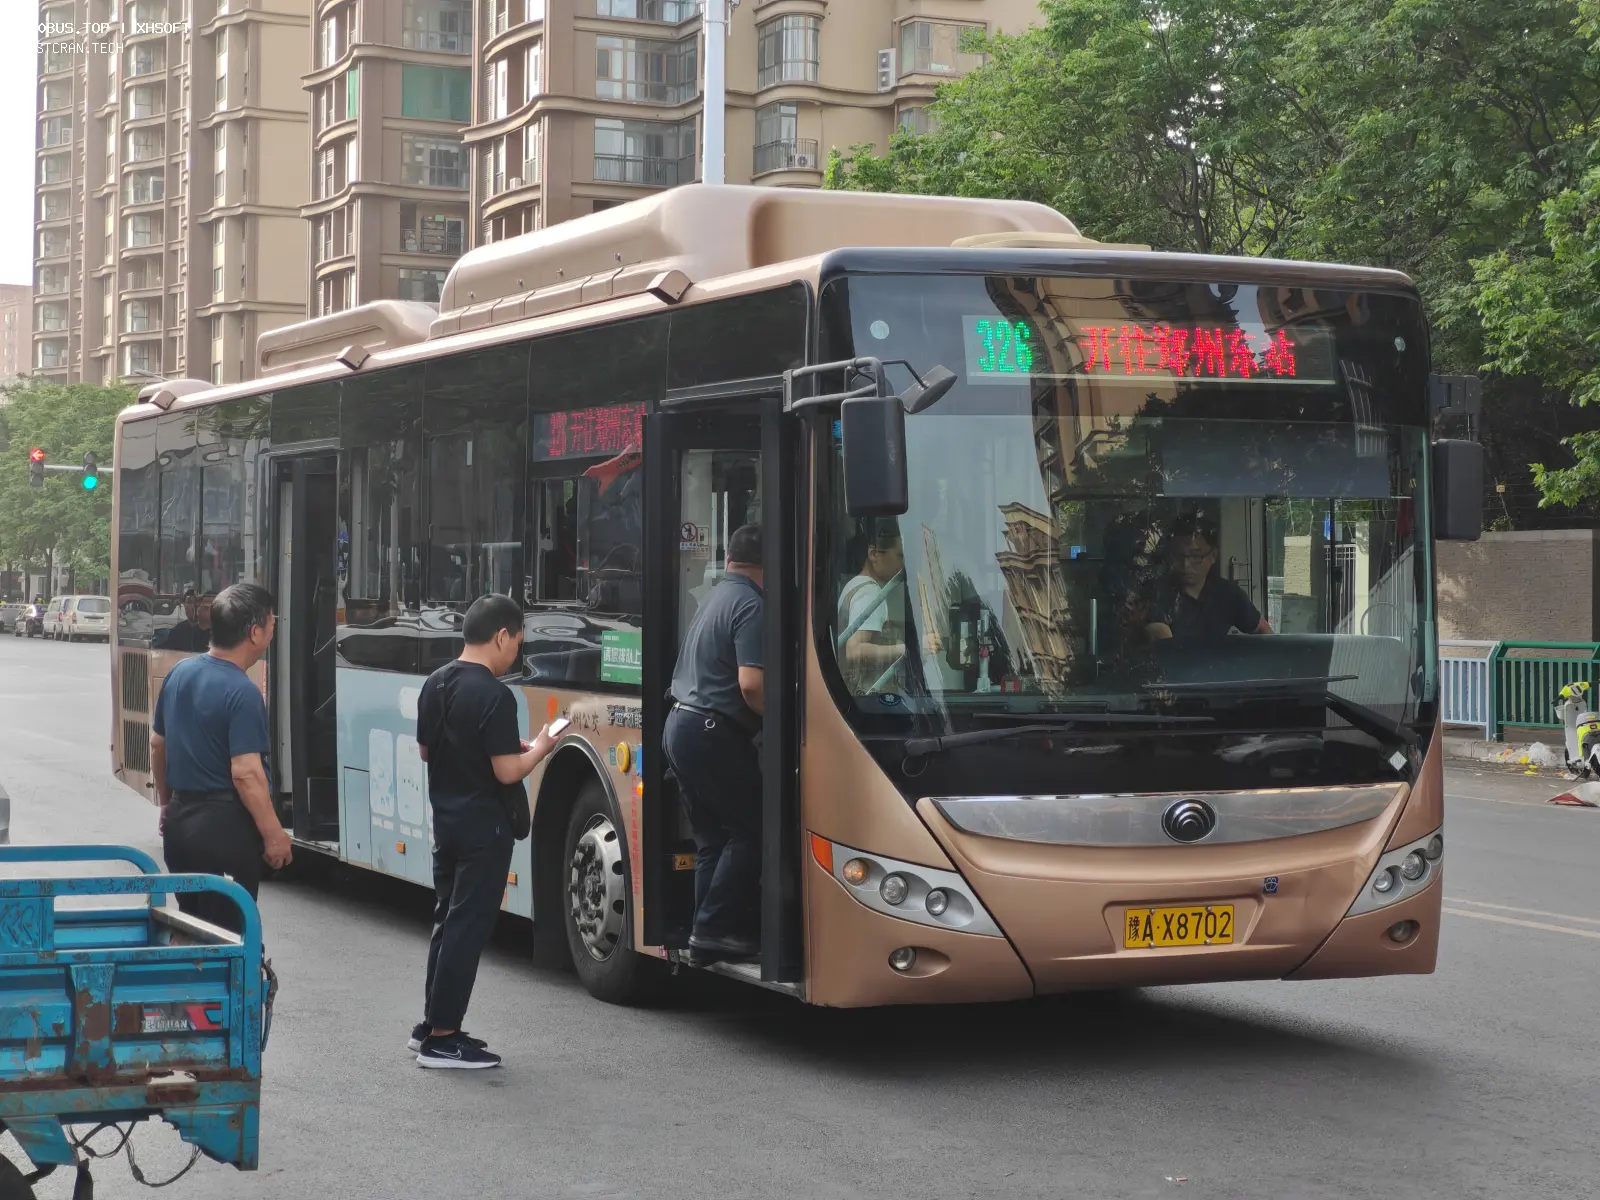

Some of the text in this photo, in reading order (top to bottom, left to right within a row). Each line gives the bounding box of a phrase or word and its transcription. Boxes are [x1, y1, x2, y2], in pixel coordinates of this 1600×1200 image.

[976, 319, 1034, 372] 326
[1080, 323, 1297, 379] 开往郑州东站
